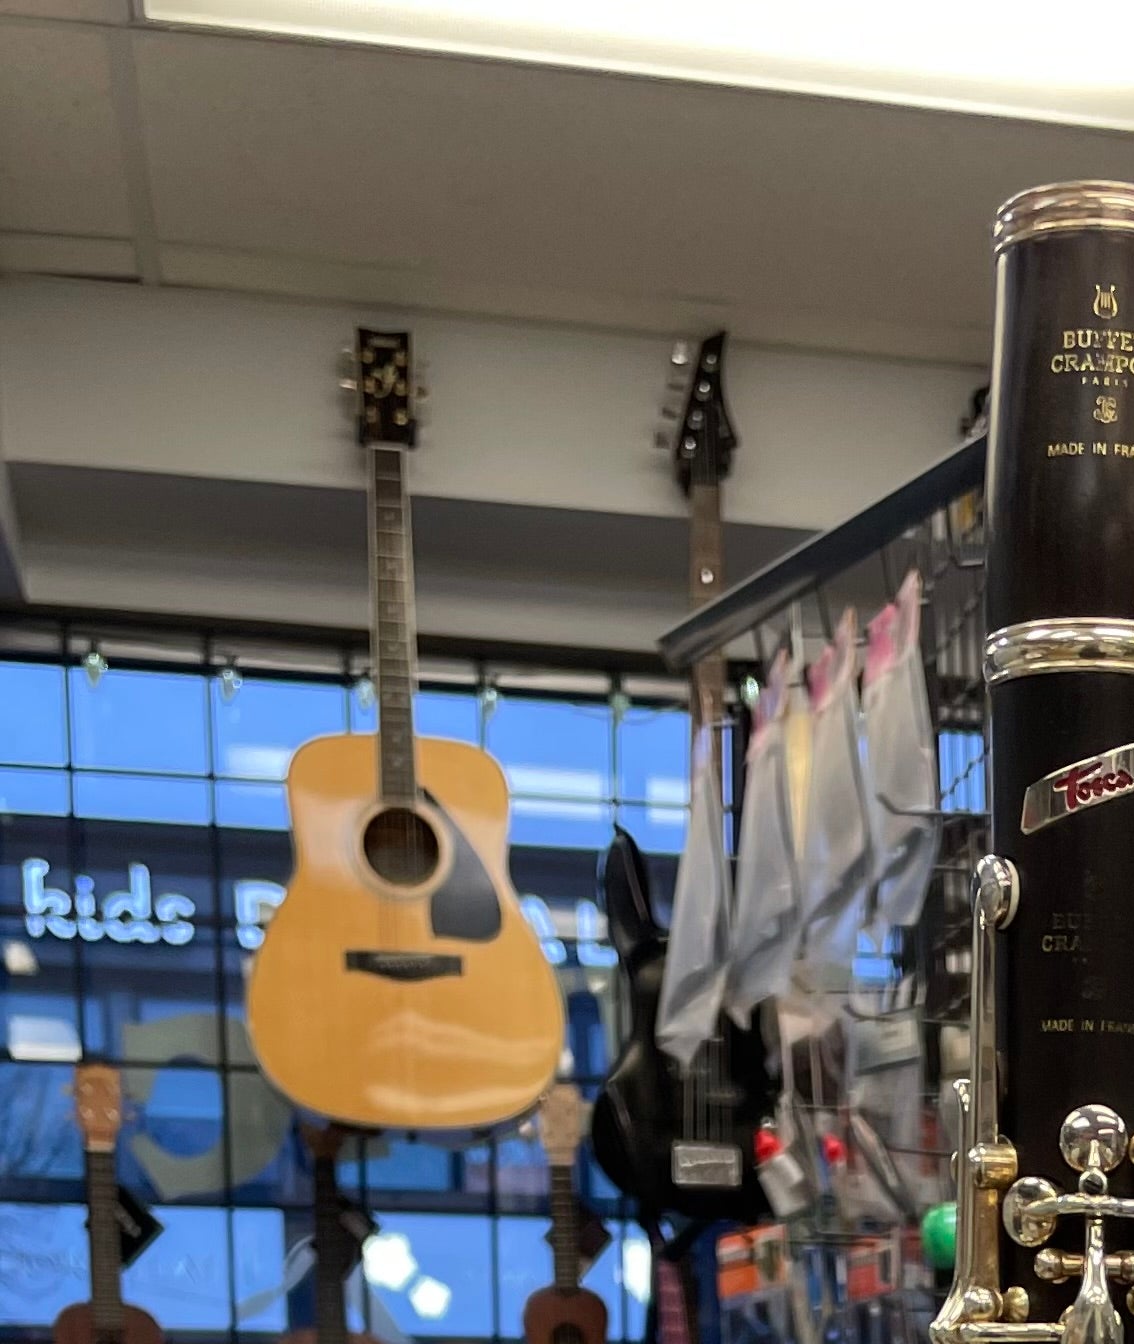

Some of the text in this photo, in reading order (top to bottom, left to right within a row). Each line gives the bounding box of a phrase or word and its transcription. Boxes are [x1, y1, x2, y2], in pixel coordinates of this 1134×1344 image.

[1047, 442, 1085, 457] MADE
[1092, 442, 1107, 455] IN
[1053, 762, 1134, 812] Tosca
[22, 857, 196, 945] kids
